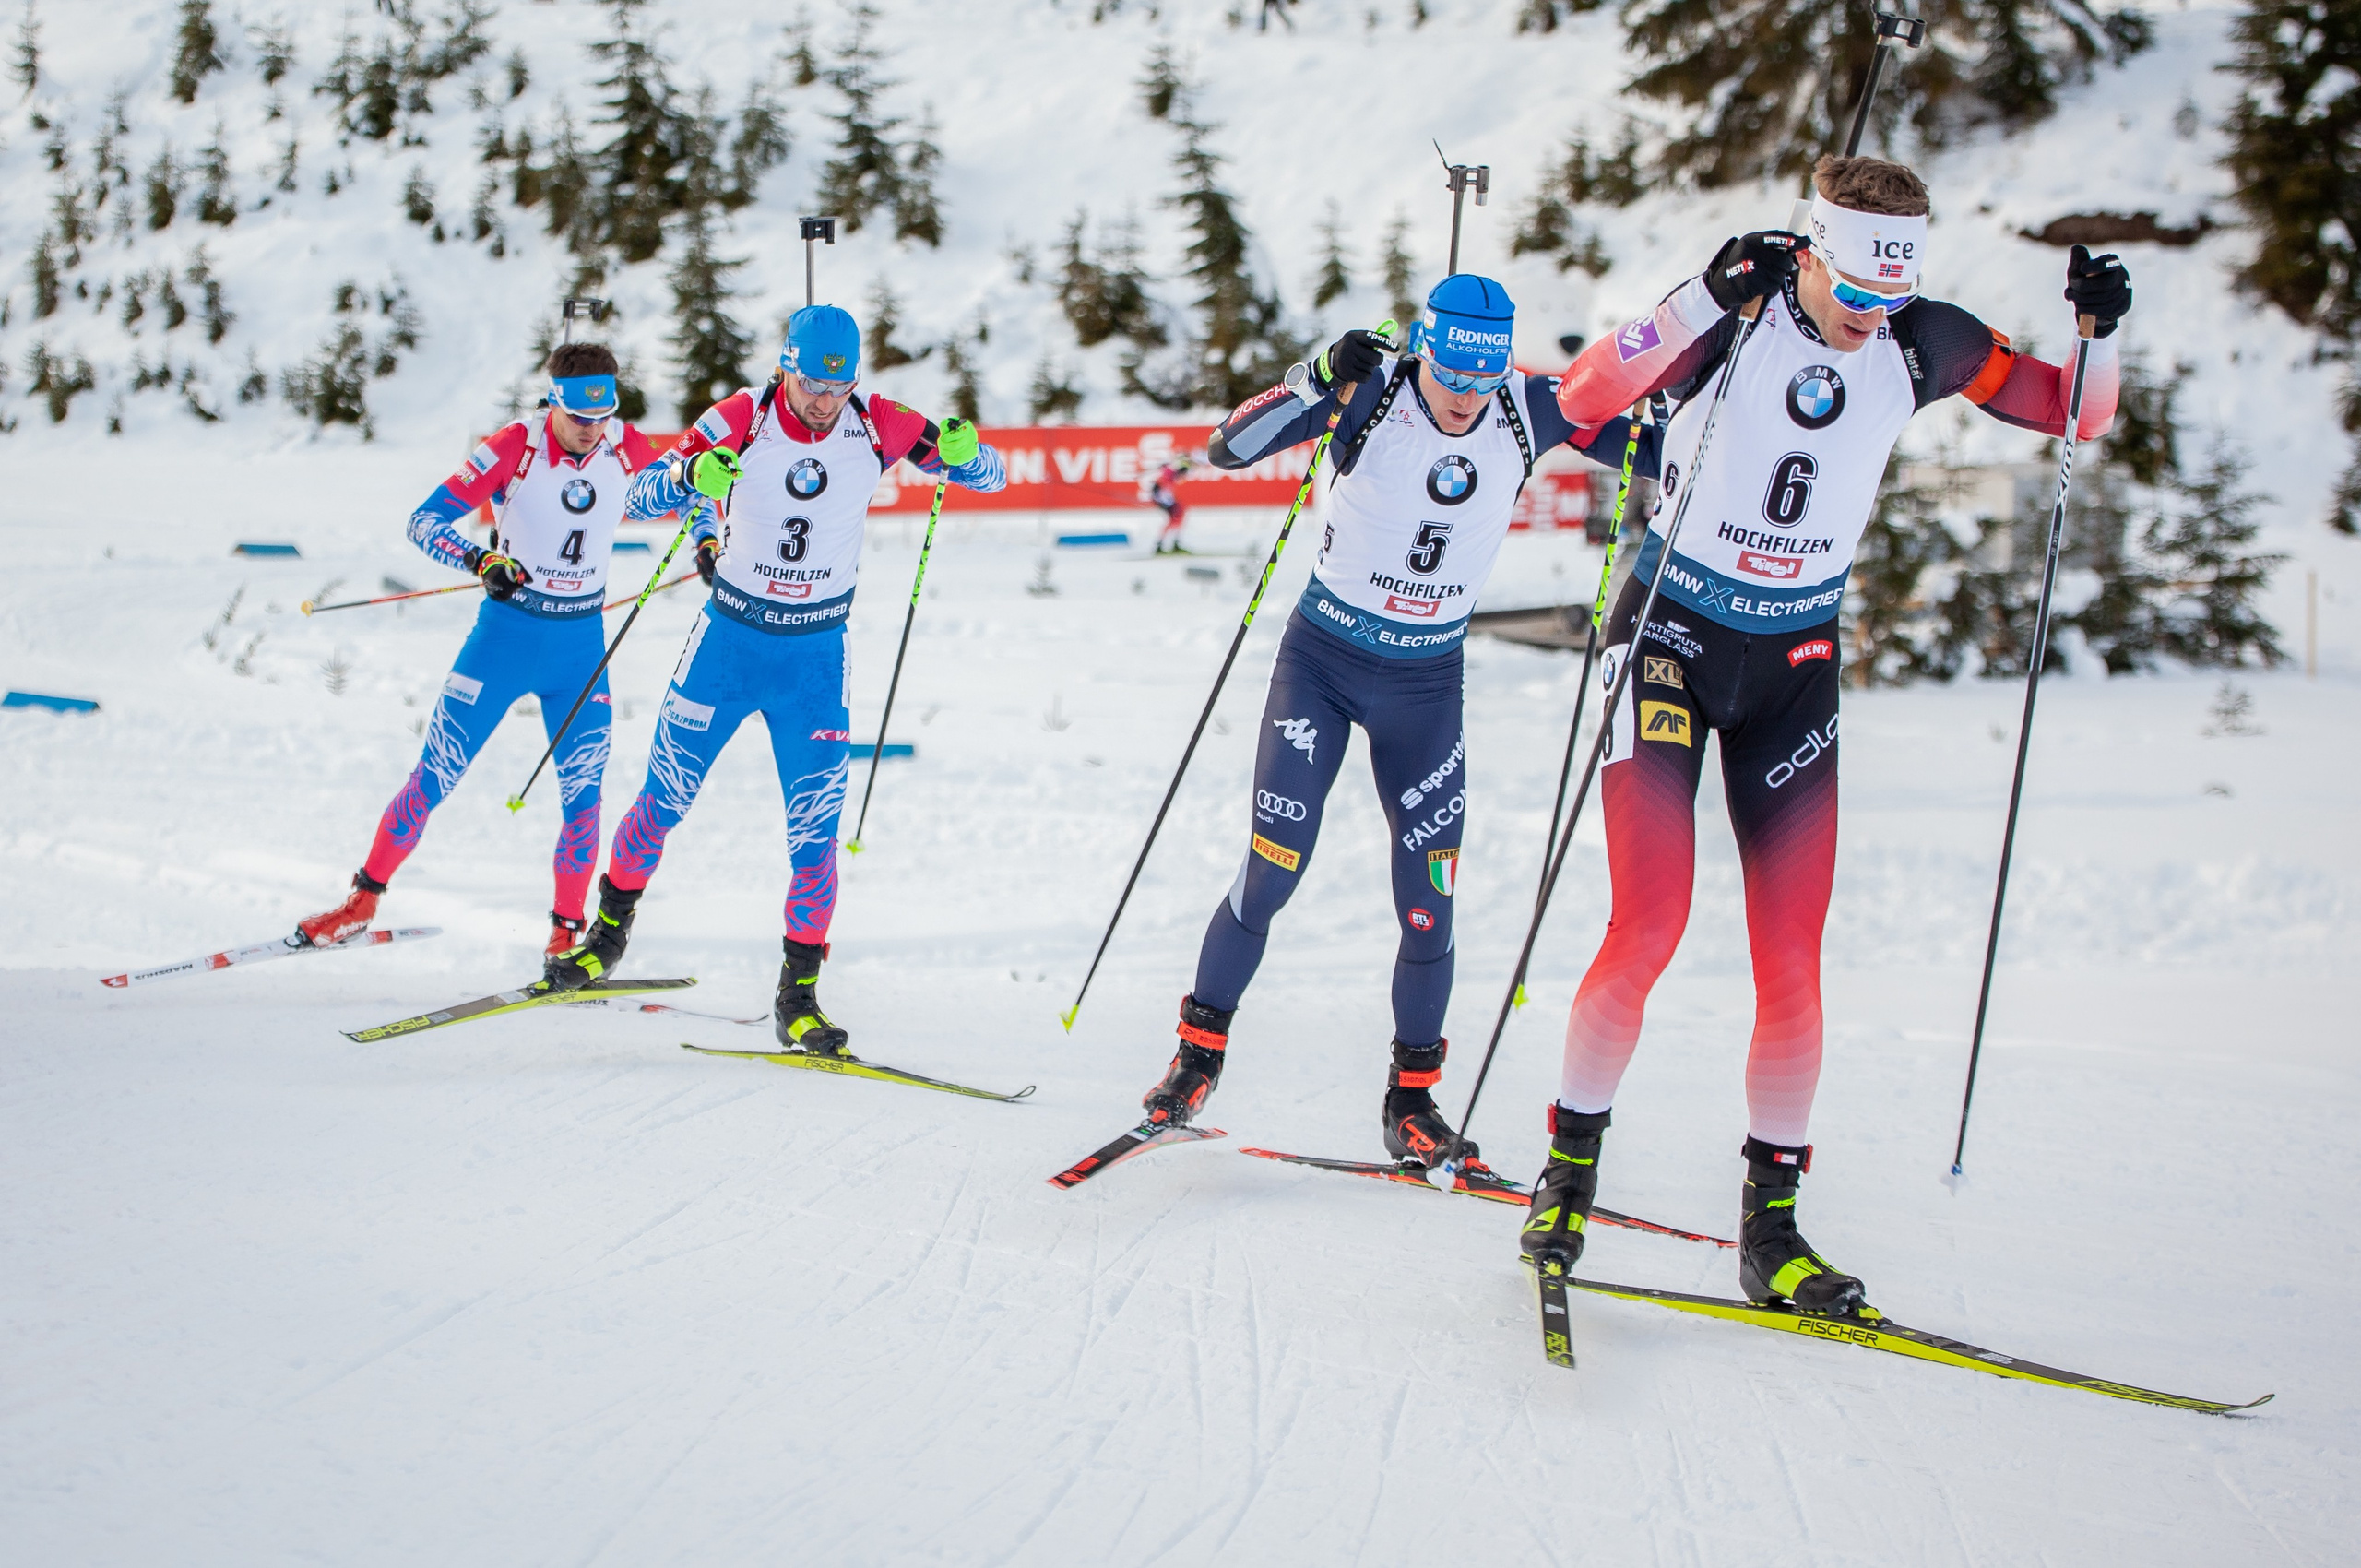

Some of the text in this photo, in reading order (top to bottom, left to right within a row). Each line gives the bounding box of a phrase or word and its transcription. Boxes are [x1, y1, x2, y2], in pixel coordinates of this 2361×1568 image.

[1872, 232, 1914, 260] ice
[1448, 326, 1509, 346] ERDINGER
[1877, 327, 1896, 340] BM
[1796, 367, 1843, 389] BMW
[1357, 376, 1400, 445] FIOCCHI
[1497, 418, 1511, 429] BM
[1500, 387, 1530, 465] FIOCCHI
[791, 459, 825, 473] BMW
[1434, 456, 1475, 474] BMW
[1662, 460, 1680, 499] 6
[1762, 451, 1819, 529] 6
[556, 529, 587, 568] 4
[777, 515, 813, 565] 3
[1406, 520, 1454, 576] 5
[1717, 521, 1835, 554] HOCHFILZEN
[535, 565, 597, 579] HOCHFILZEN
[753, 563, 832, 581] HOCHFILZEN
[1747, 556, 1796, 576] Tirol
[1370, 572, 1467, 599] HOCHFILZEN
[1699, 578, 1734, 613] X
[717, 588, 848, 625] BMW X ELECTRIFIED
[1316, 599, 1356, 628] BMW
[1352, 615, 1382, 644] X
[1631, 615, 1703, 654] HRTIGRUTA
[1643, 630, 1695, 659] ARGLASS
[1792, 644, 1829, 662] MENY
[670, 713, 707, 729] GAZPROM
[1256, 811, 1274, 824] Audi
[1255, 838, 1296, 866] PIRELLI
[355, 1015, 432, 1041] FISCHER
[804, 1058, 845, 1073] FISCHER
[1797, 1319, 1879, 1347] FISCHER
